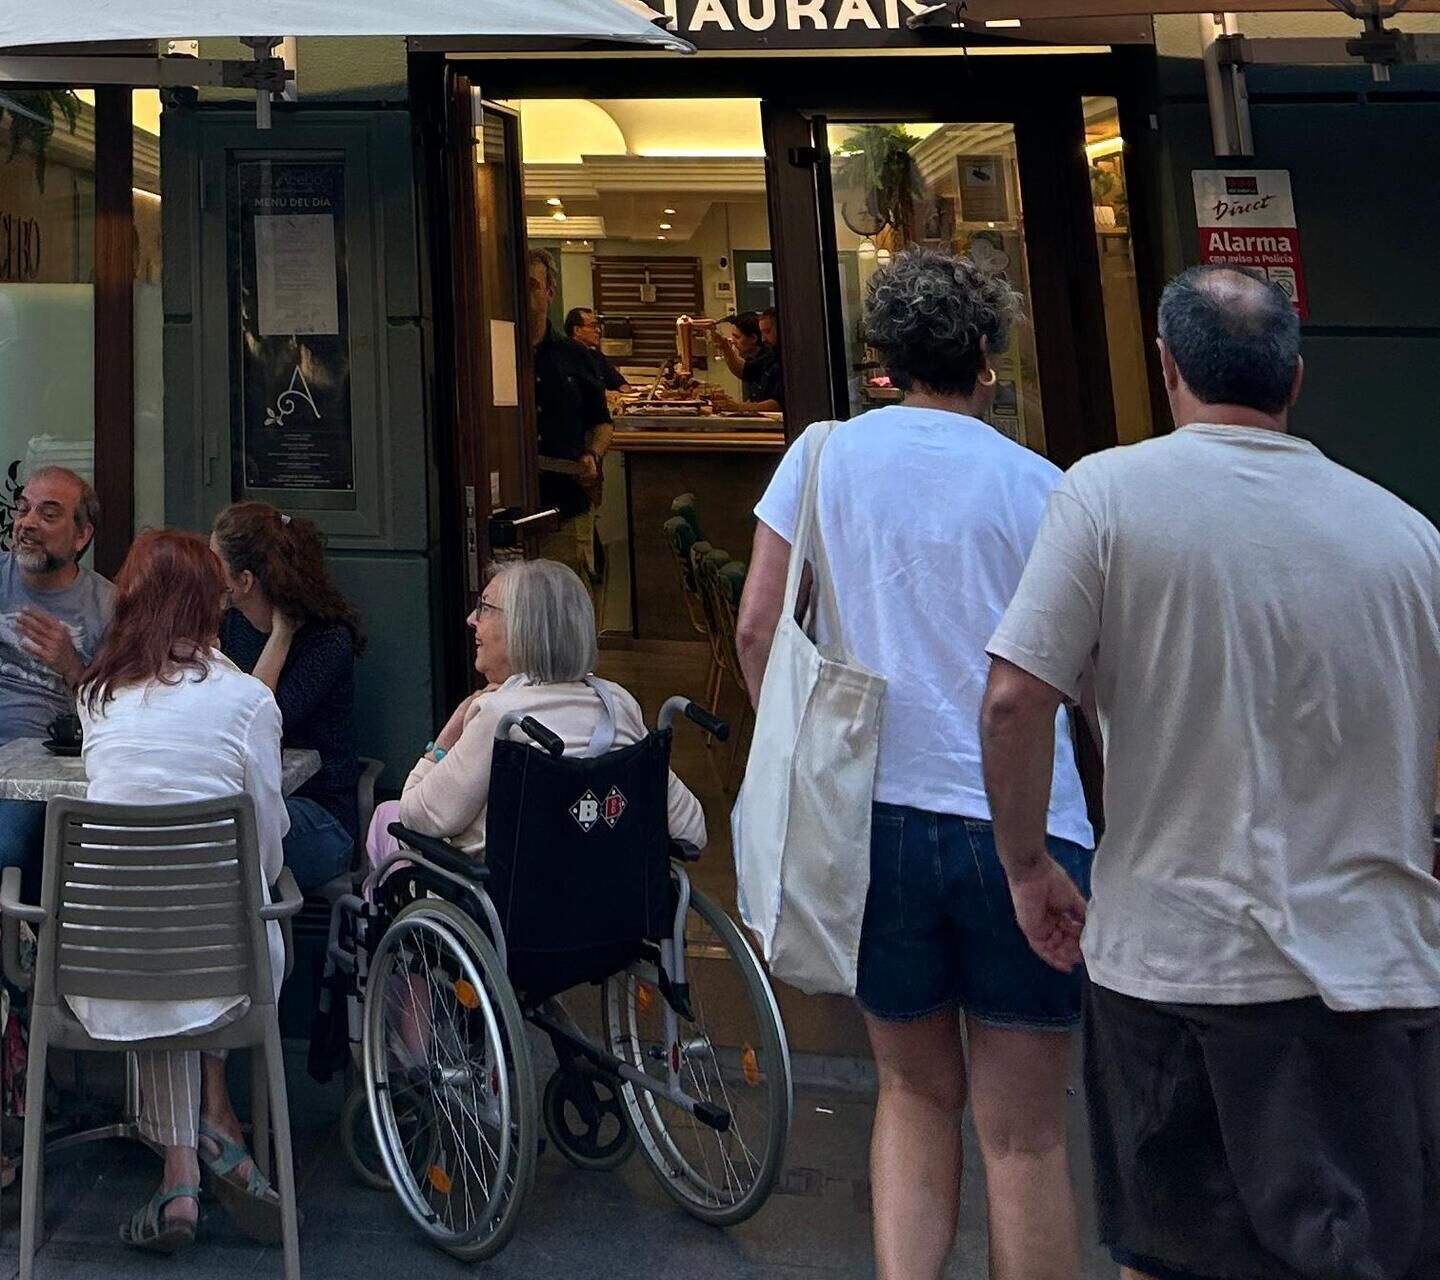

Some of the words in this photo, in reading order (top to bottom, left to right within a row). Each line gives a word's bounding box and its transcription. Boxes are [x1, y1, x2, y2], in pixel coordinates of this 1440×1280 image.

[254, 195, 287, 208] MENÚ
[289, 197, 310, 207] DEL
[312, 194, 331, 207] DÍA
[1213, 194, 1277, 221] Direct
[1208, 231, 1292, 252] Alarma
[1228, 253, 1253, 263] aviso
[578, 799, 599, 823] B
